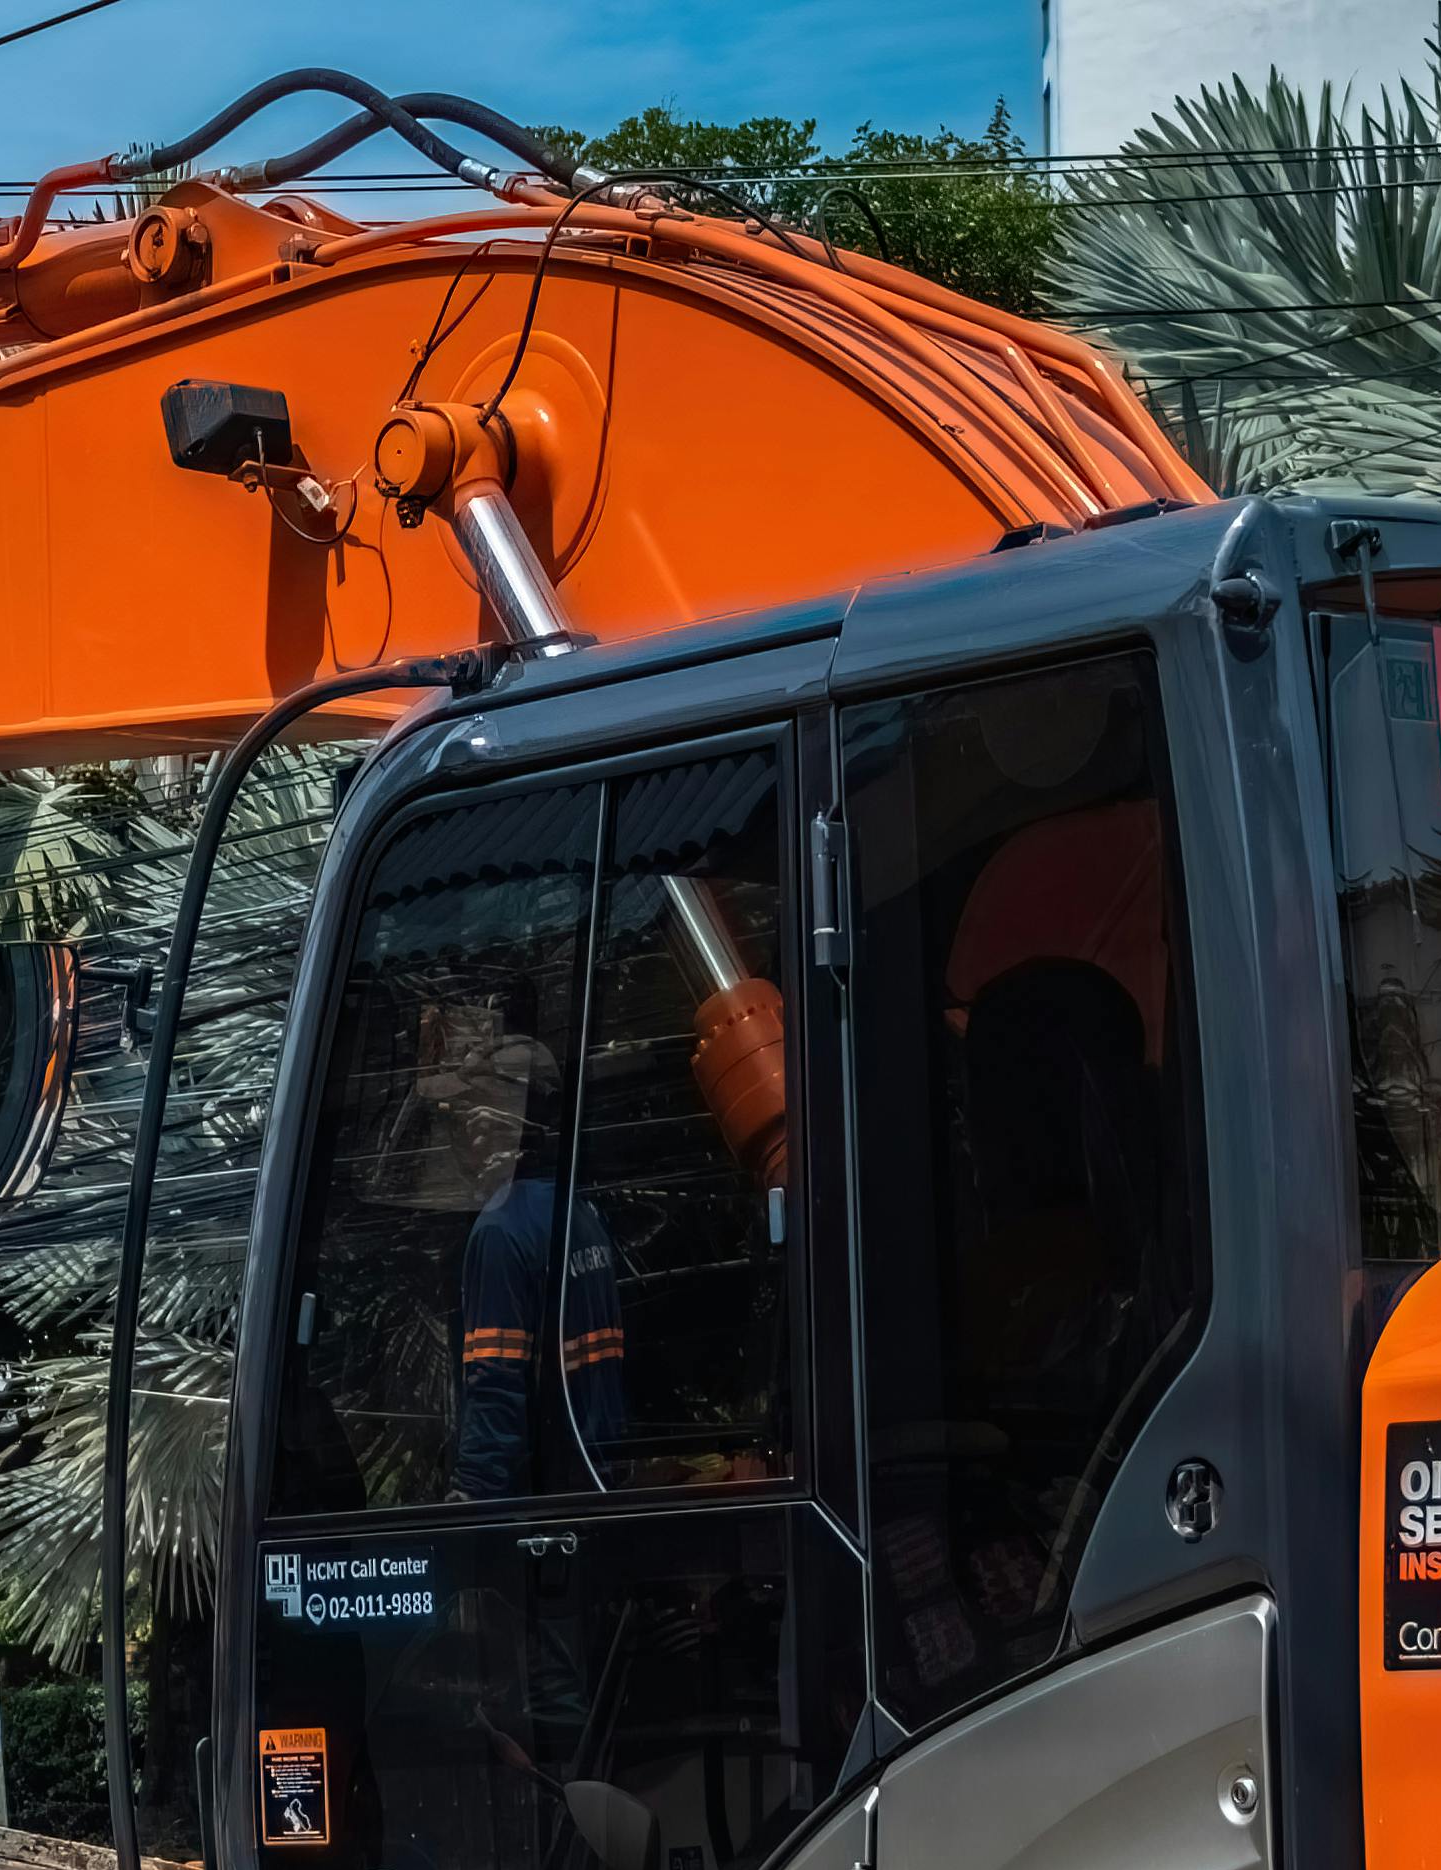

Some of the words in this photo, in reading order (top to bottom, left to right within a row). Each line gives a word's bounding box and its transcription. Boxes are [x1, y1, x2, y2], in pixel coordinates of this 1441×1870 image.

[307, 1561, 347, 1581] HCMT
[350, 1558, 377, 1578] Call
[380, 1556, 429, 1576] Center
[329, 1591, 433, 1619] 02-011-9888
